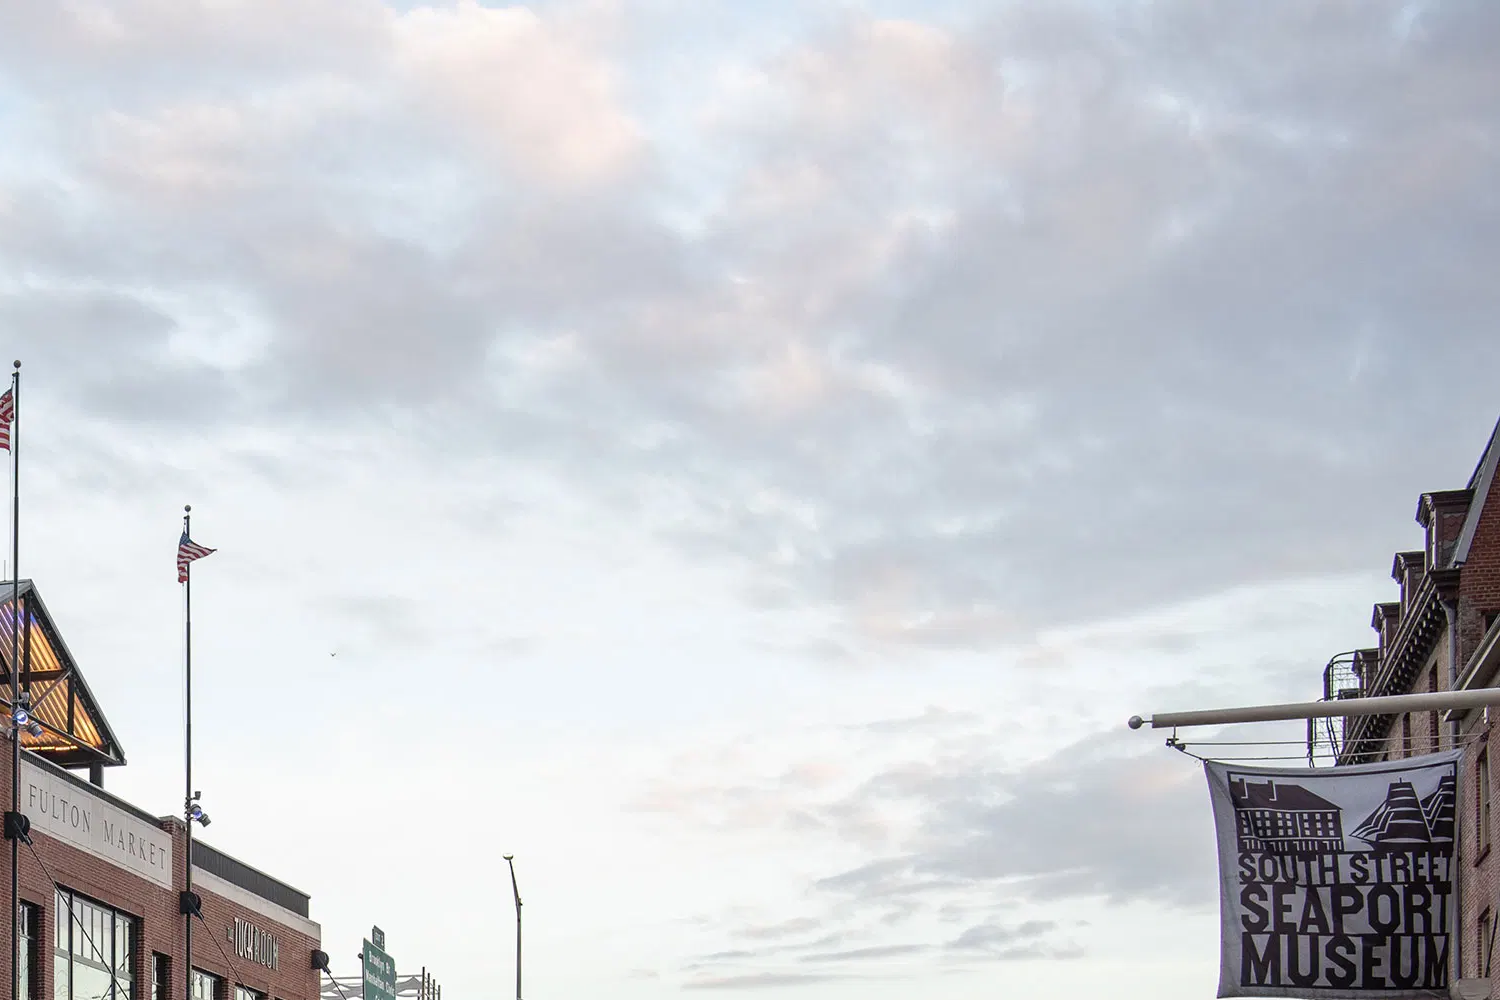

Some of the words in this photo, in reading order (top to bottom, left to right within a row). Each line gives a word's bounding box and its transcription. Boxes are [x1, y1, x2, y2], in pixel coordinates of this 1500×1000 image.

[29, 783, 92, 833] FULTON
[103, 819, 167, 870] MARKET
[1238, 851, 1340, 884] SOUTH
[1349, 851, 1452, 884] STREET
[1240, 882, 1452, 934] SEAPORT
[1241, 932, 1449, 988] MUSEUM
